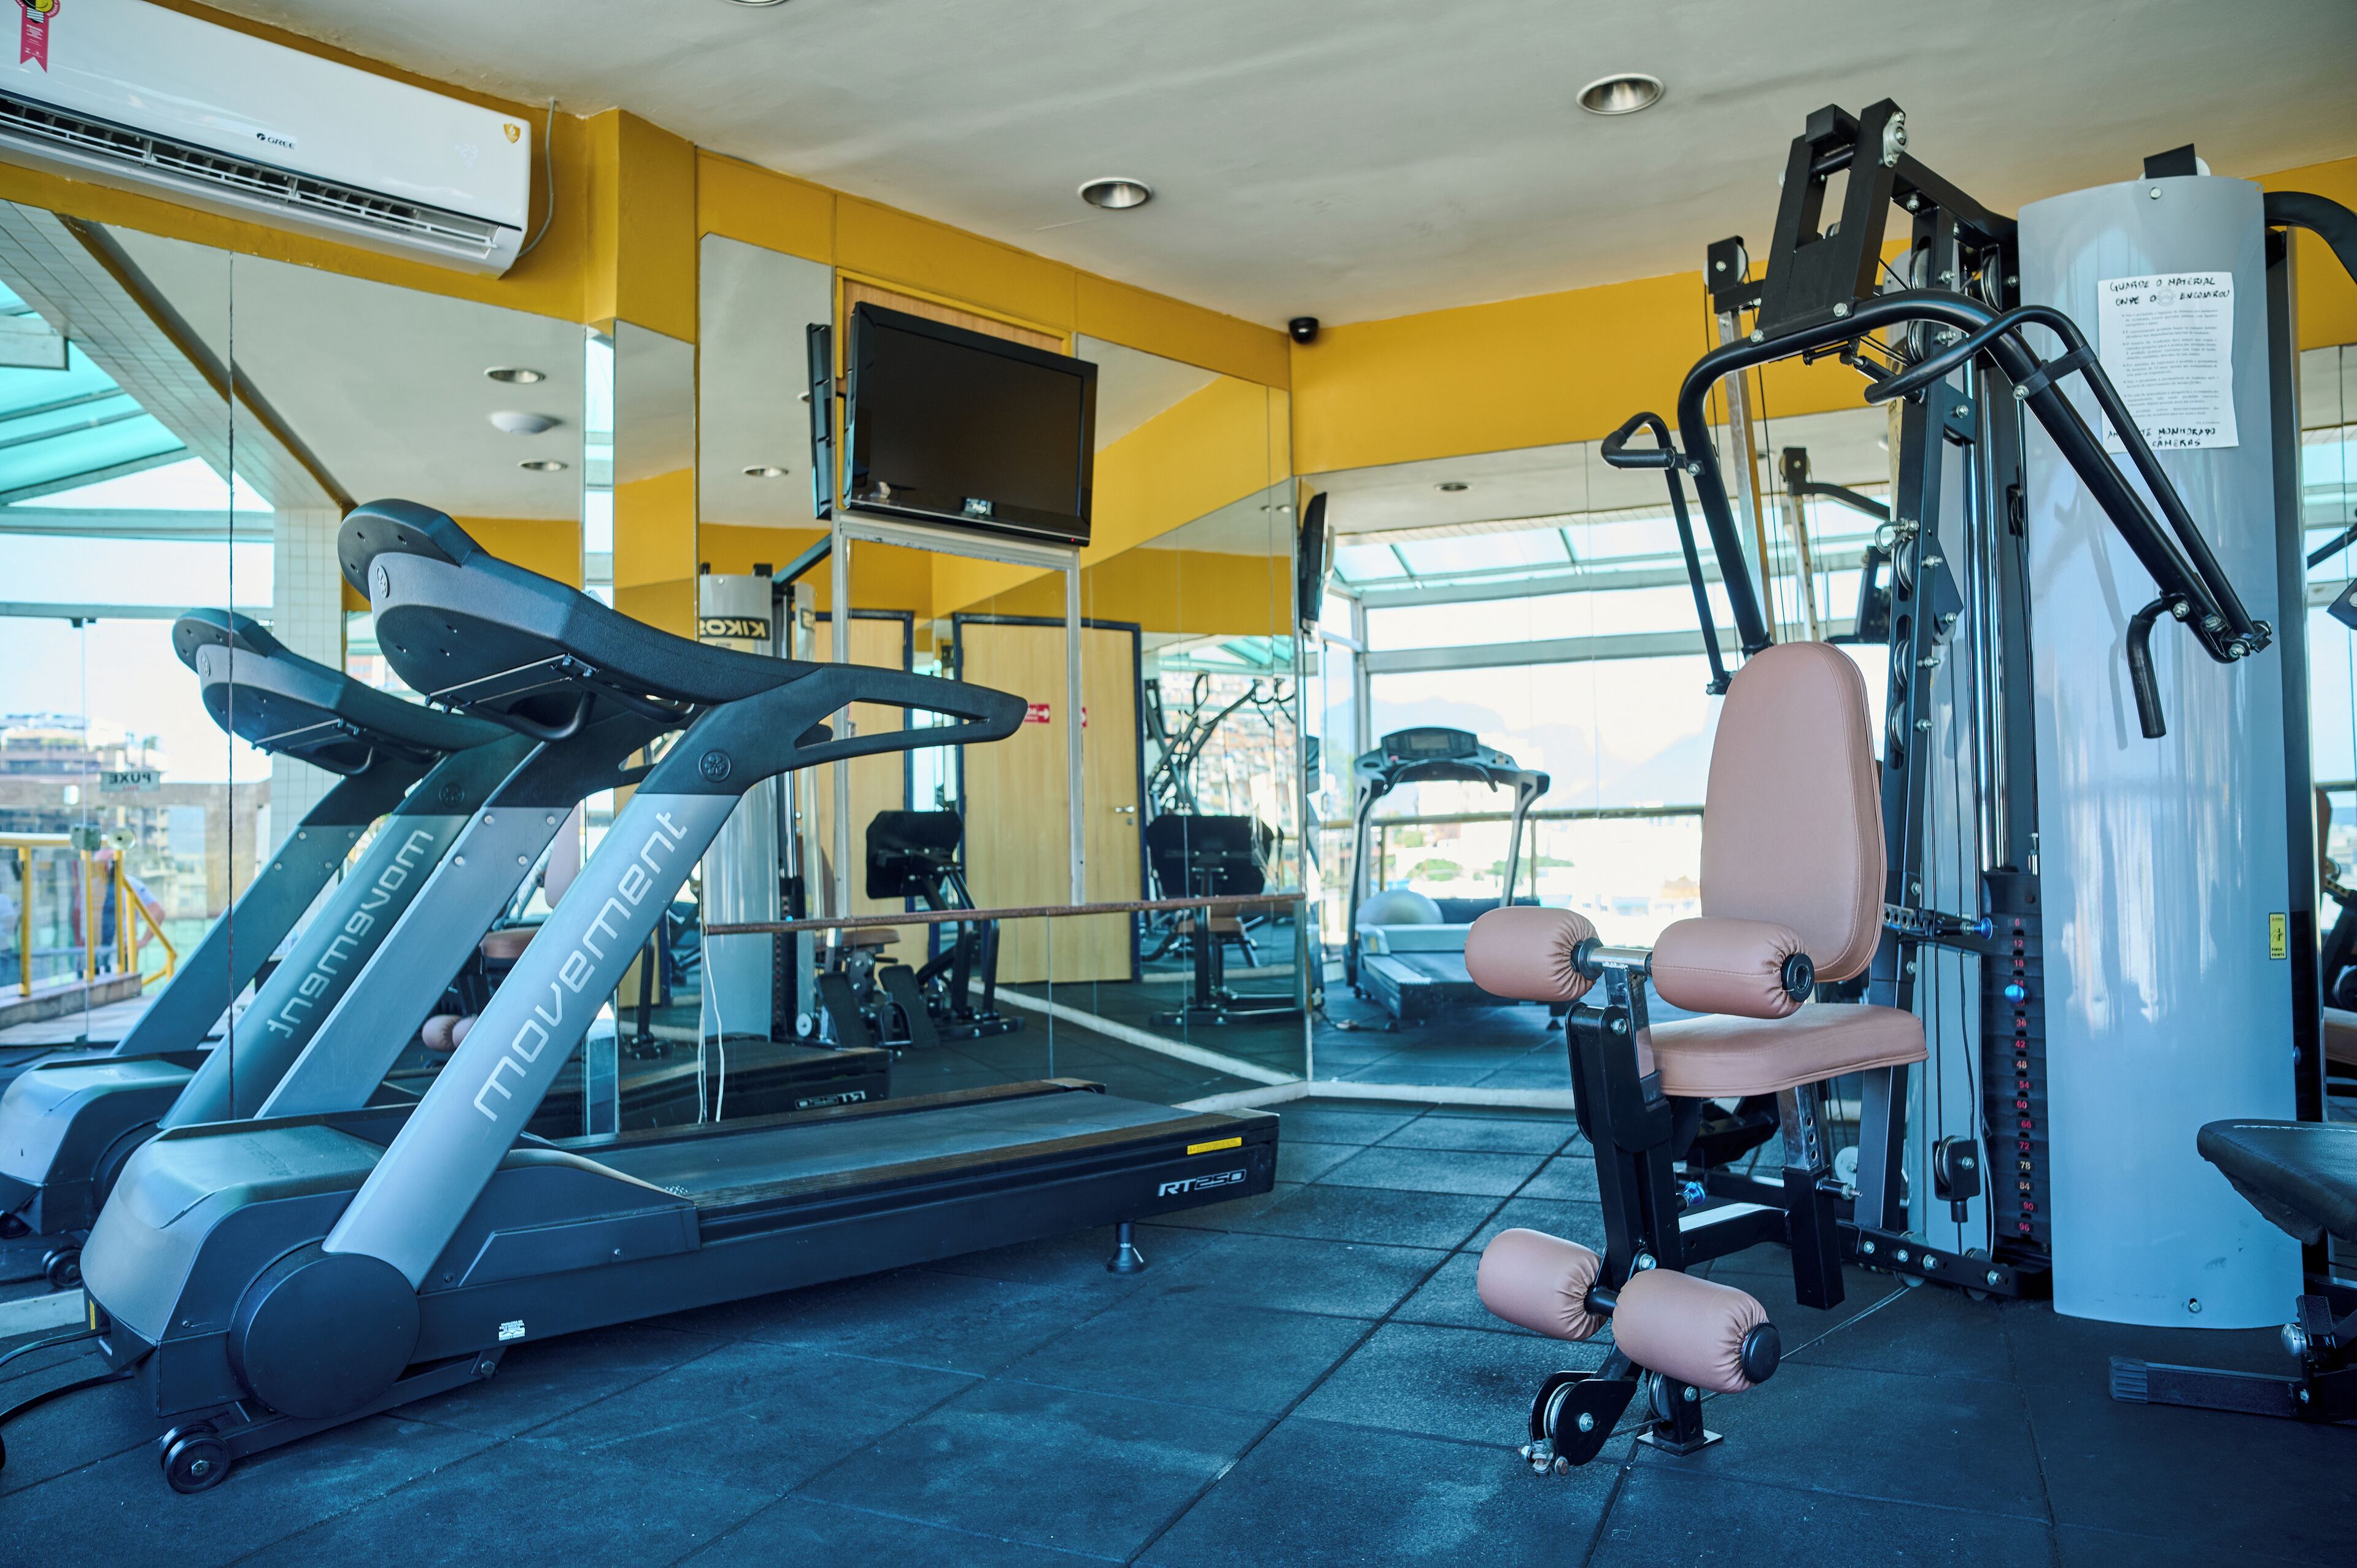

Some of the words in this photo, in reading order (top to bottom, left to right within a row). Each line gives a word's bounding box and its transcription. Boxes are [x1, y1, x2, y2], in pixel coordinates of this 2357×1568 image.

[268, 137, 296, 150] GREE
[2110, 280, 2150, 292] GUARDE
[2168, 277, 2215, 286] MATERIAL
[2116, 298, 2140, 306] ONDE
[2152, 436, 2201, 447] CÂMERAS
[2014, 918, 2021, 927] 6
[474, 811, 687, 1122] movement
[2016, 1018, 2027, 1027] 36
[2016, 1060, 2027, 1068] 48
[2019, 1080, 2029, 1089] 54
[2017, 1100, 2027, 1109] 60
[2021, 1120, 2032, 1129] 66
[2019, 1141, 2030, 1150] 72
[2020, 1161, 2031, 1170] 78
[1158, 1168, 1247, 1197] RT250
[2019, 1181, 2030, 1191] 84
[2023, 1202, 2034, 1211] 90
[2019, 1222, 2030, 1232] 96
